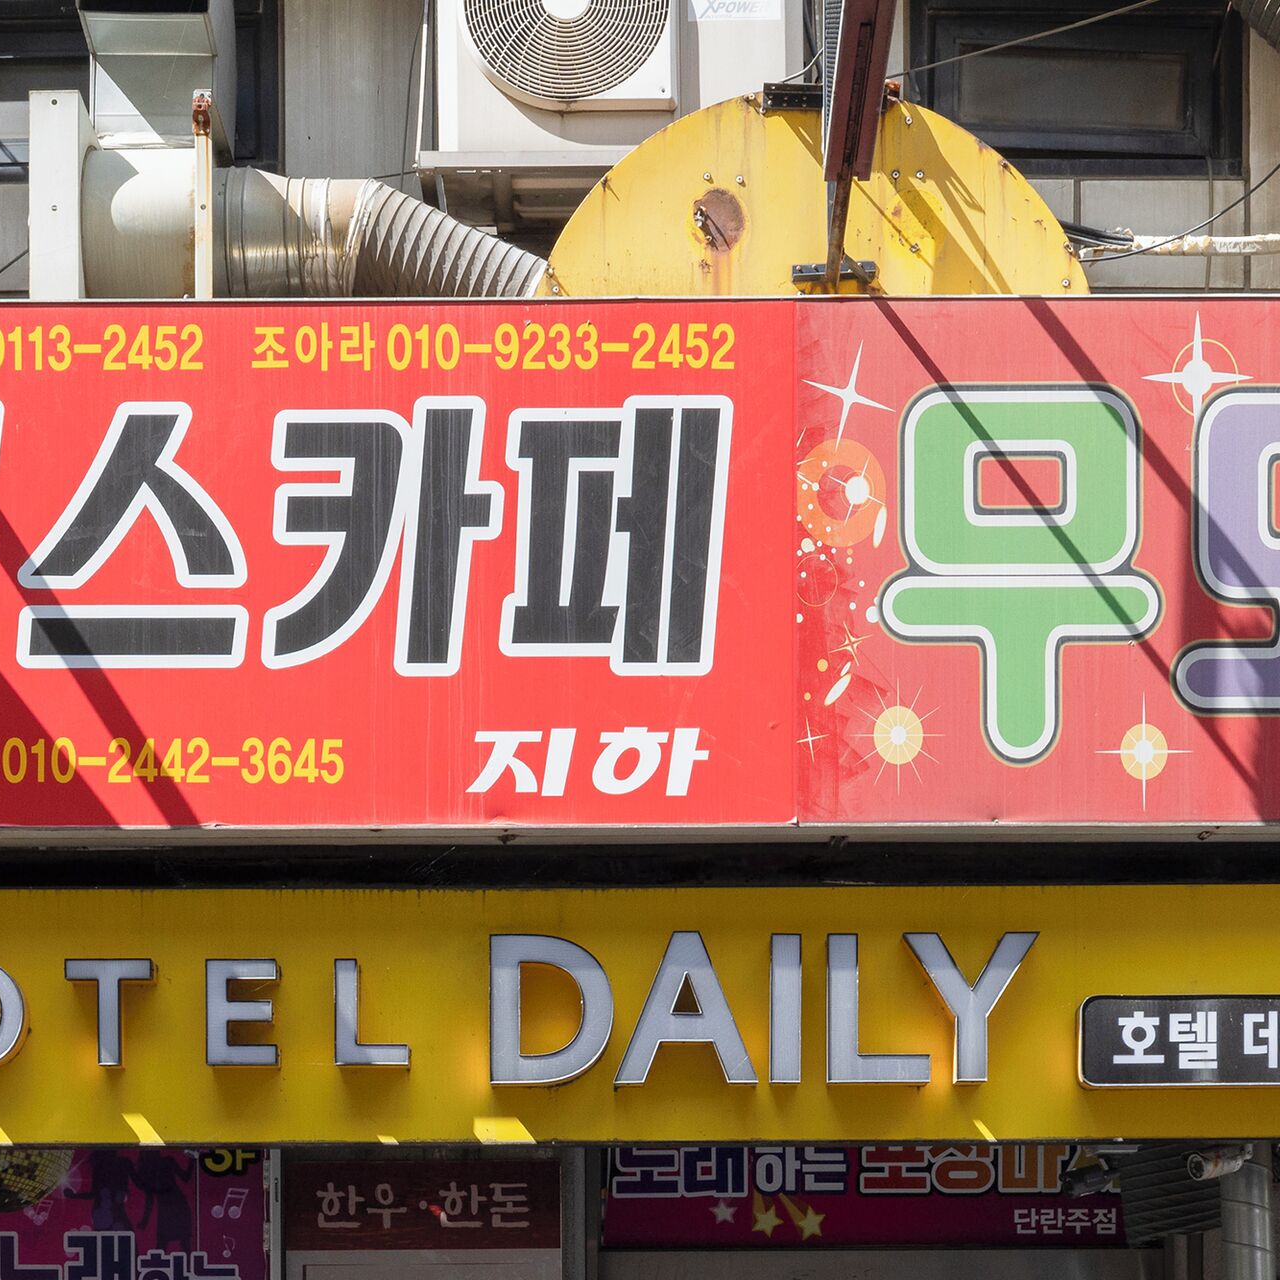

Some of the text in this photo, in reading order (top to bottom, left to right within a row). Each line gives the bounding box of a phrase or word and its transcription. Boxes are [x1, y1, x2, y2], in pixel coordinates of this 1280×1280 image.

[251, 322, 375, 371] 조아라
[388, 322, 736, 371] 010-9233-2452
[3, 735, 345, 786] 010-2442-3645
[465, 726, 710, 796] 지하
[488, 930, 1039, 1086] DAILY
[1113, 1011, 1218, 1069] 호텔
[1013, 1207, 1118, 1234] 단란주점
